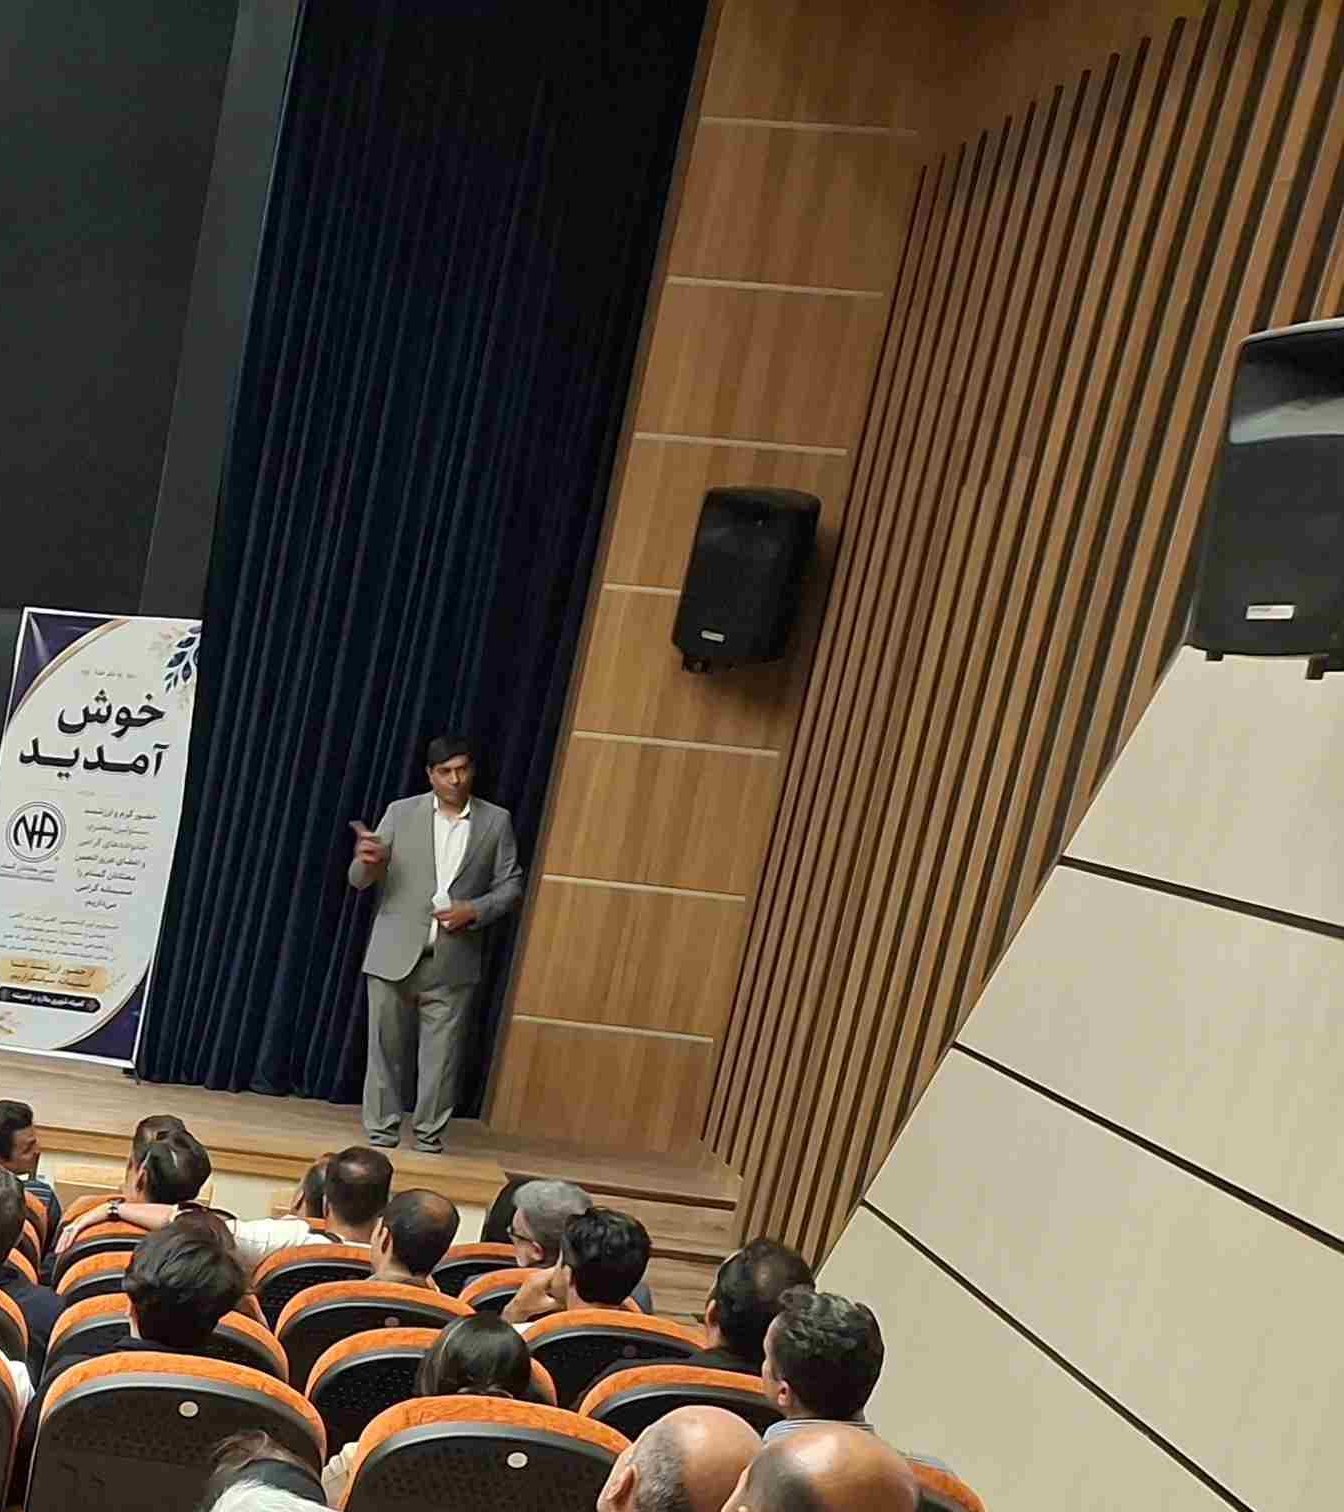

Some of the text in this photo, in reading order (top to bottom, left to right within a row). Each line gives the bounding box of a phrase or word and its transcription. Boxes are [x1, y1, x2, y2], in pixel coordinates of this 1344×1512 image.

[57, 689, 166, 739] خوش
[18, 737, 170, 779] آمدید
[12, 810, 60, 852] NA
